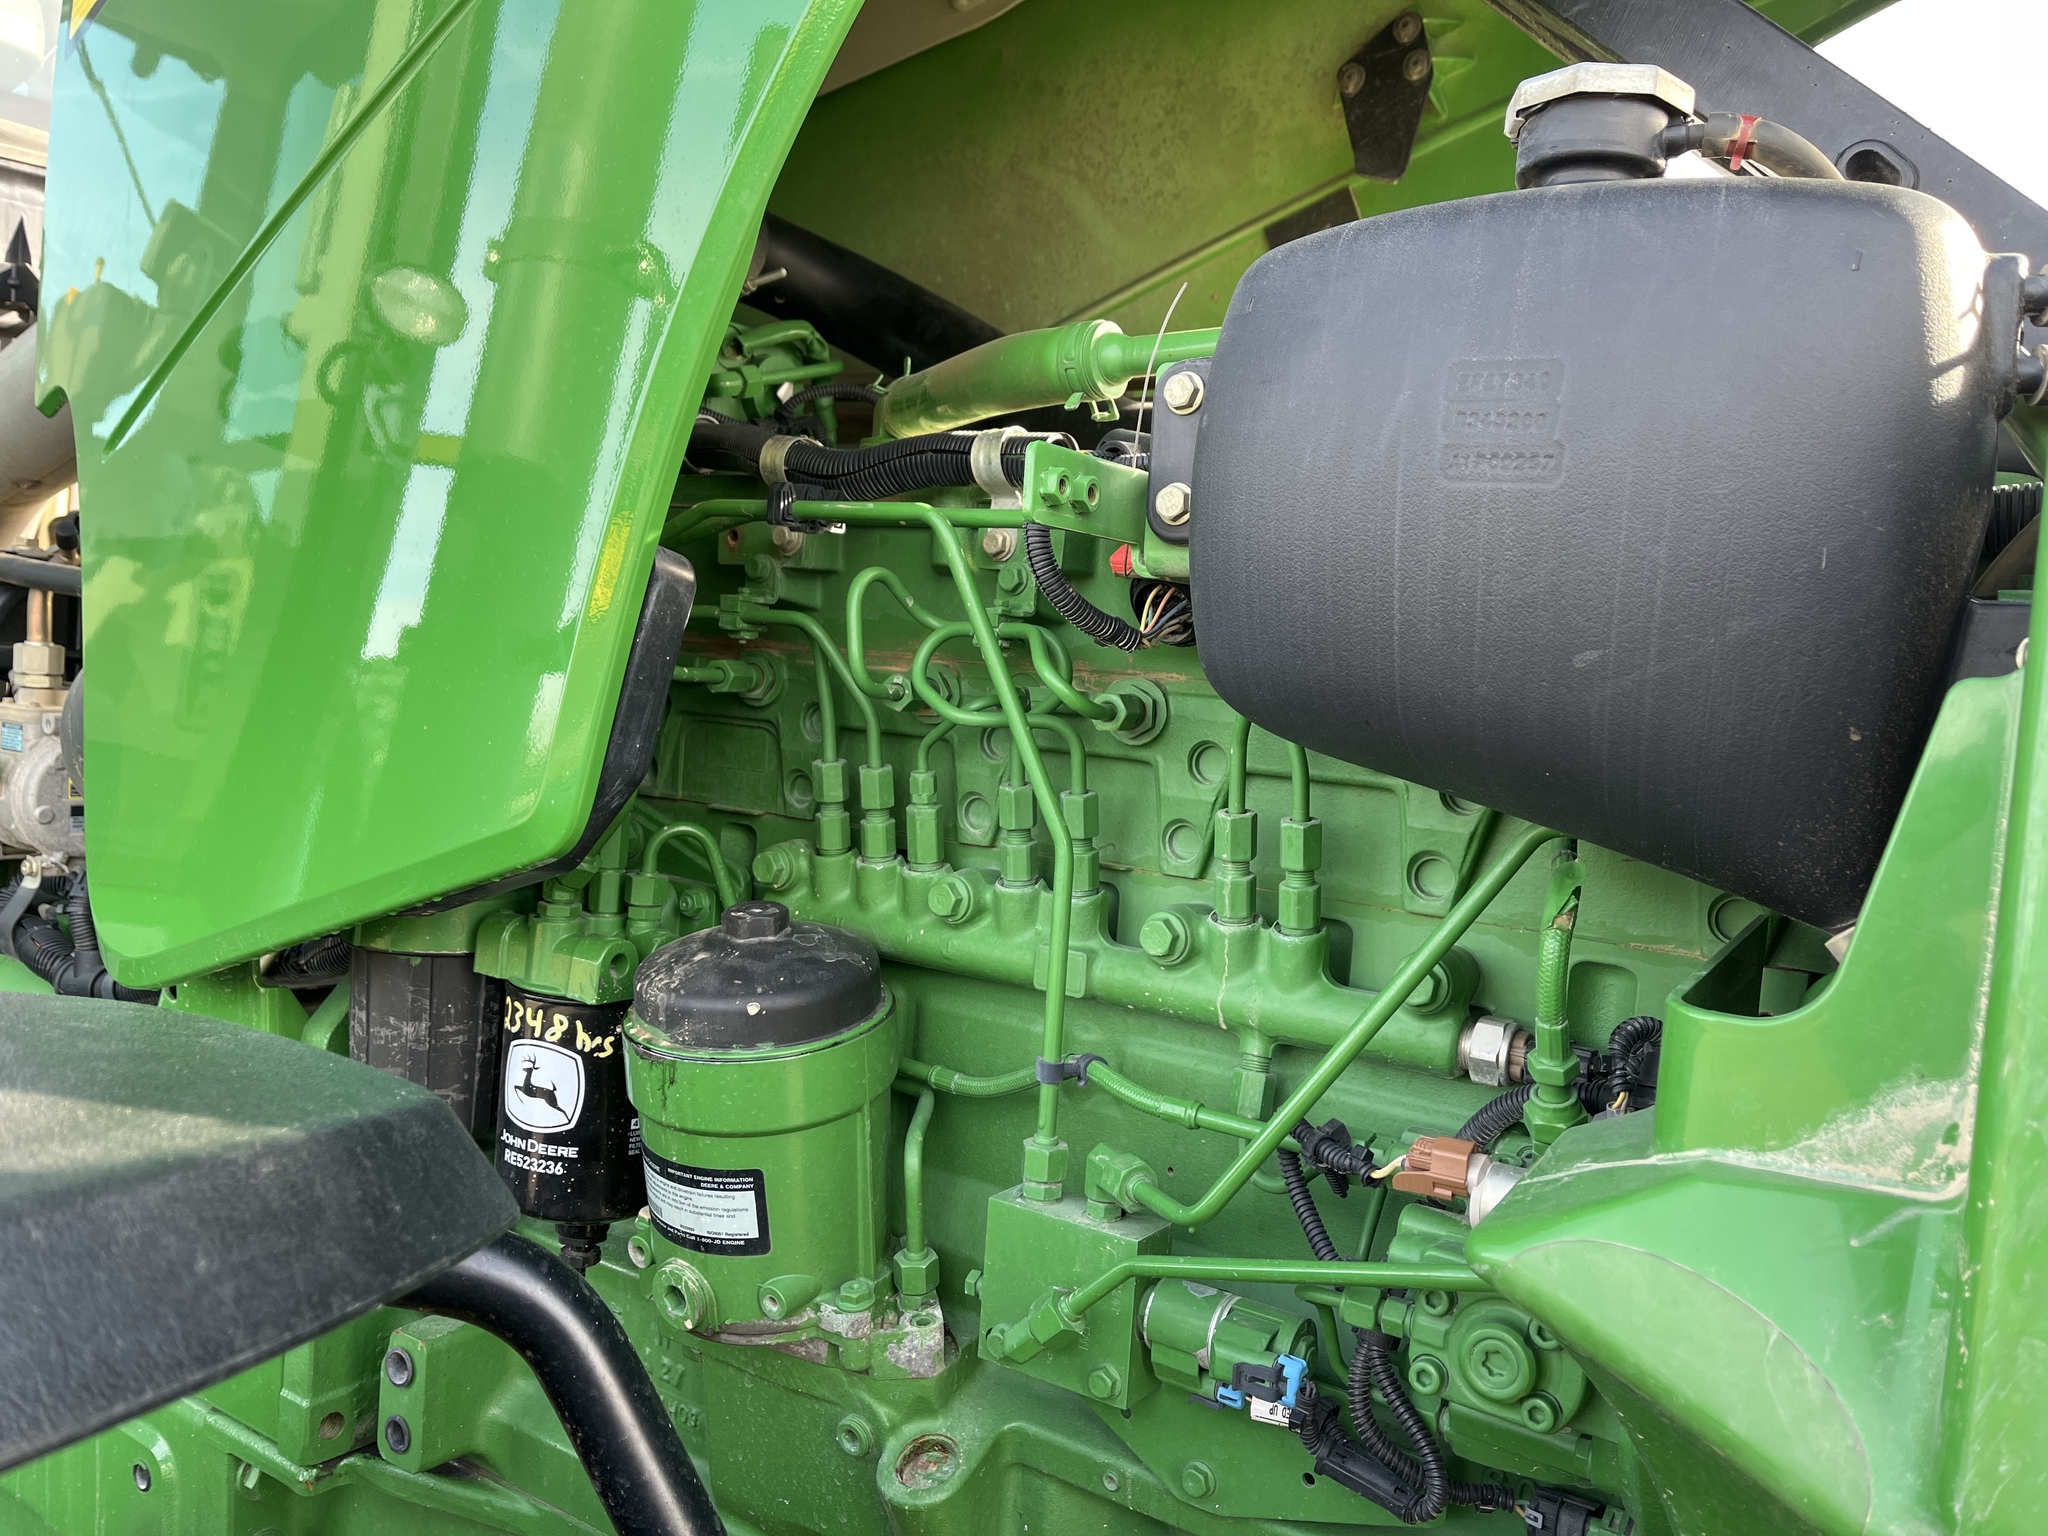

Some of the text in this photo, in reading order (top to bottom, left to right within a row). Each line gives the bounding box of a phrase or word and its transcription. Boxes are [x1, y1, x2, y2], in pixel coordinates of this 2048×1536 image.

[504, 996, 615, 1058] 2348 hrs
[500, 1128, 579, 1158] JOHN DEERE
[504, 1148, 564, 1176] RE523236
[667, 1167, 693, 1180] IMPORTANT
